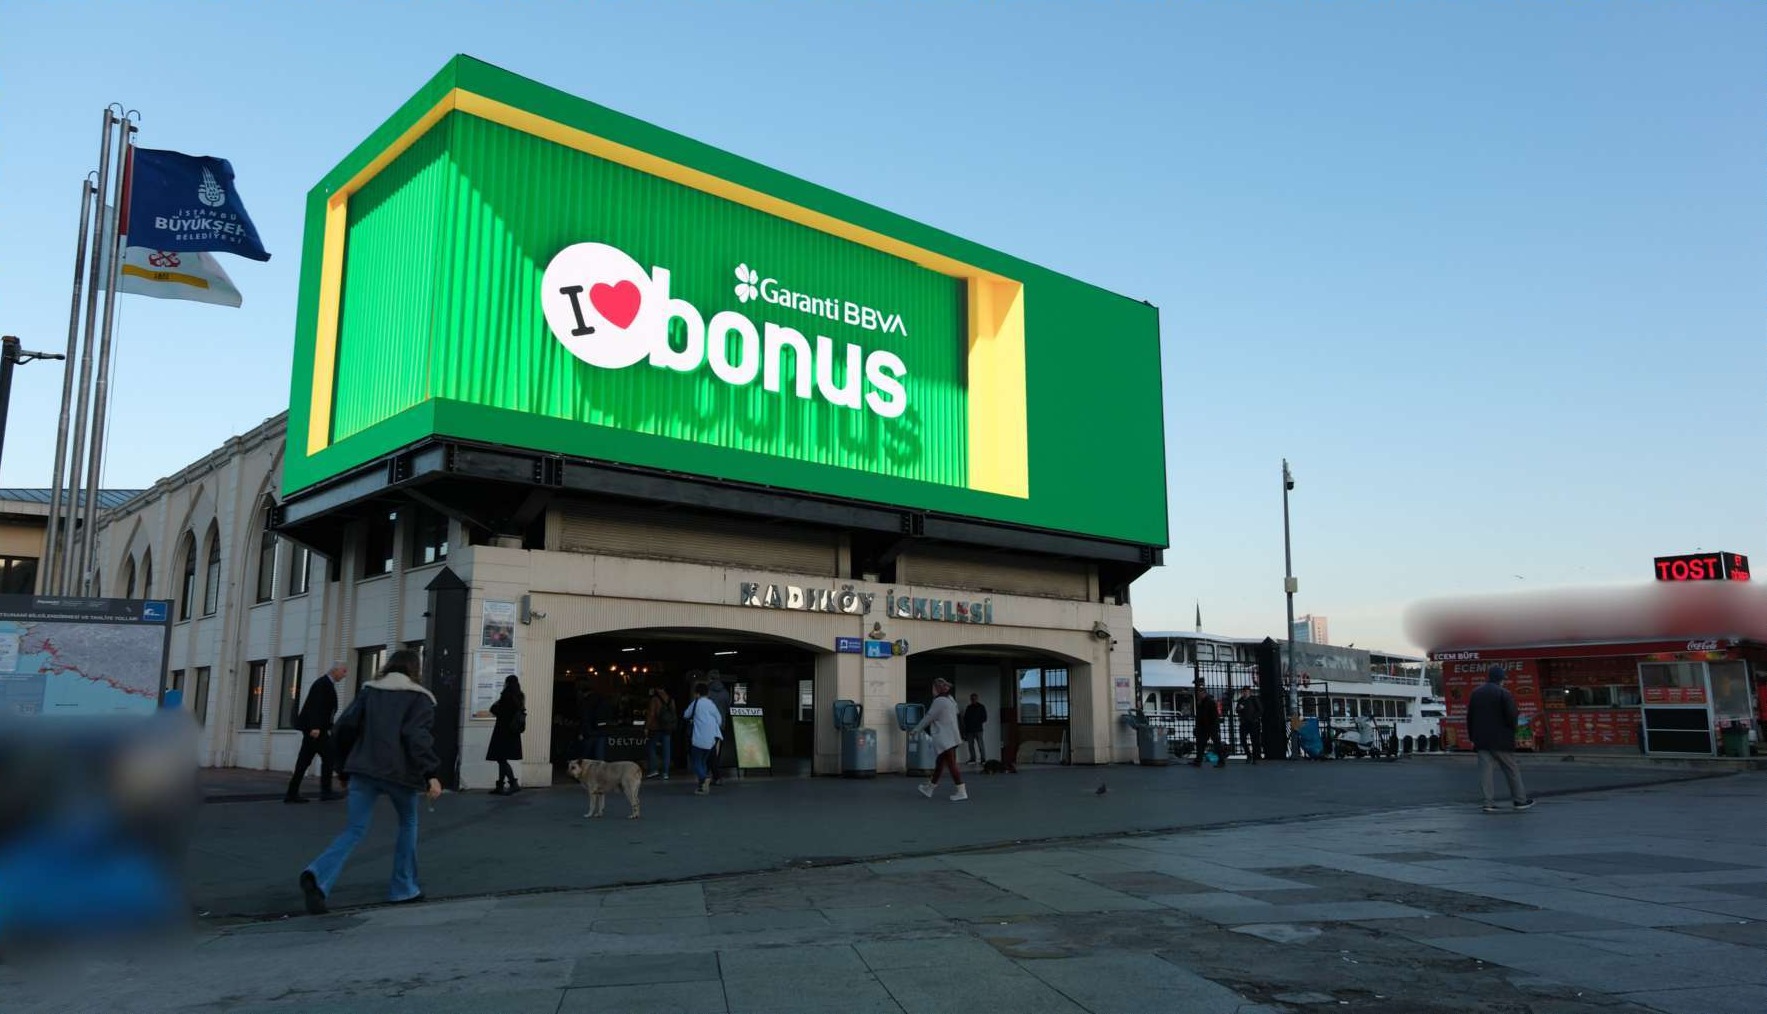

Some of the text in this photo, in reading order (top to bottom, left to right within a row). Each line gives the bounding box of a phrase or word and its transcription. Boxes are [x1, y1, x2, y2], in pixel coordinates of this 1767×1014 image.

[155, 215, 247, 237] BÜYÜKŞEH
[178, 209, 237, 221] İSTANBU
[760, 278, 908, 337] Garanti BBVA
[559, 265, 908, 418] I bonus
[1657, 558, 1717, 580] TOST
[740, 582, 993, 624] KADIKÖY İSKELESİ
[1434, 651, 1479, 660] ECEM BÜFE
[1454, 662, 1486, 673] ECEM
